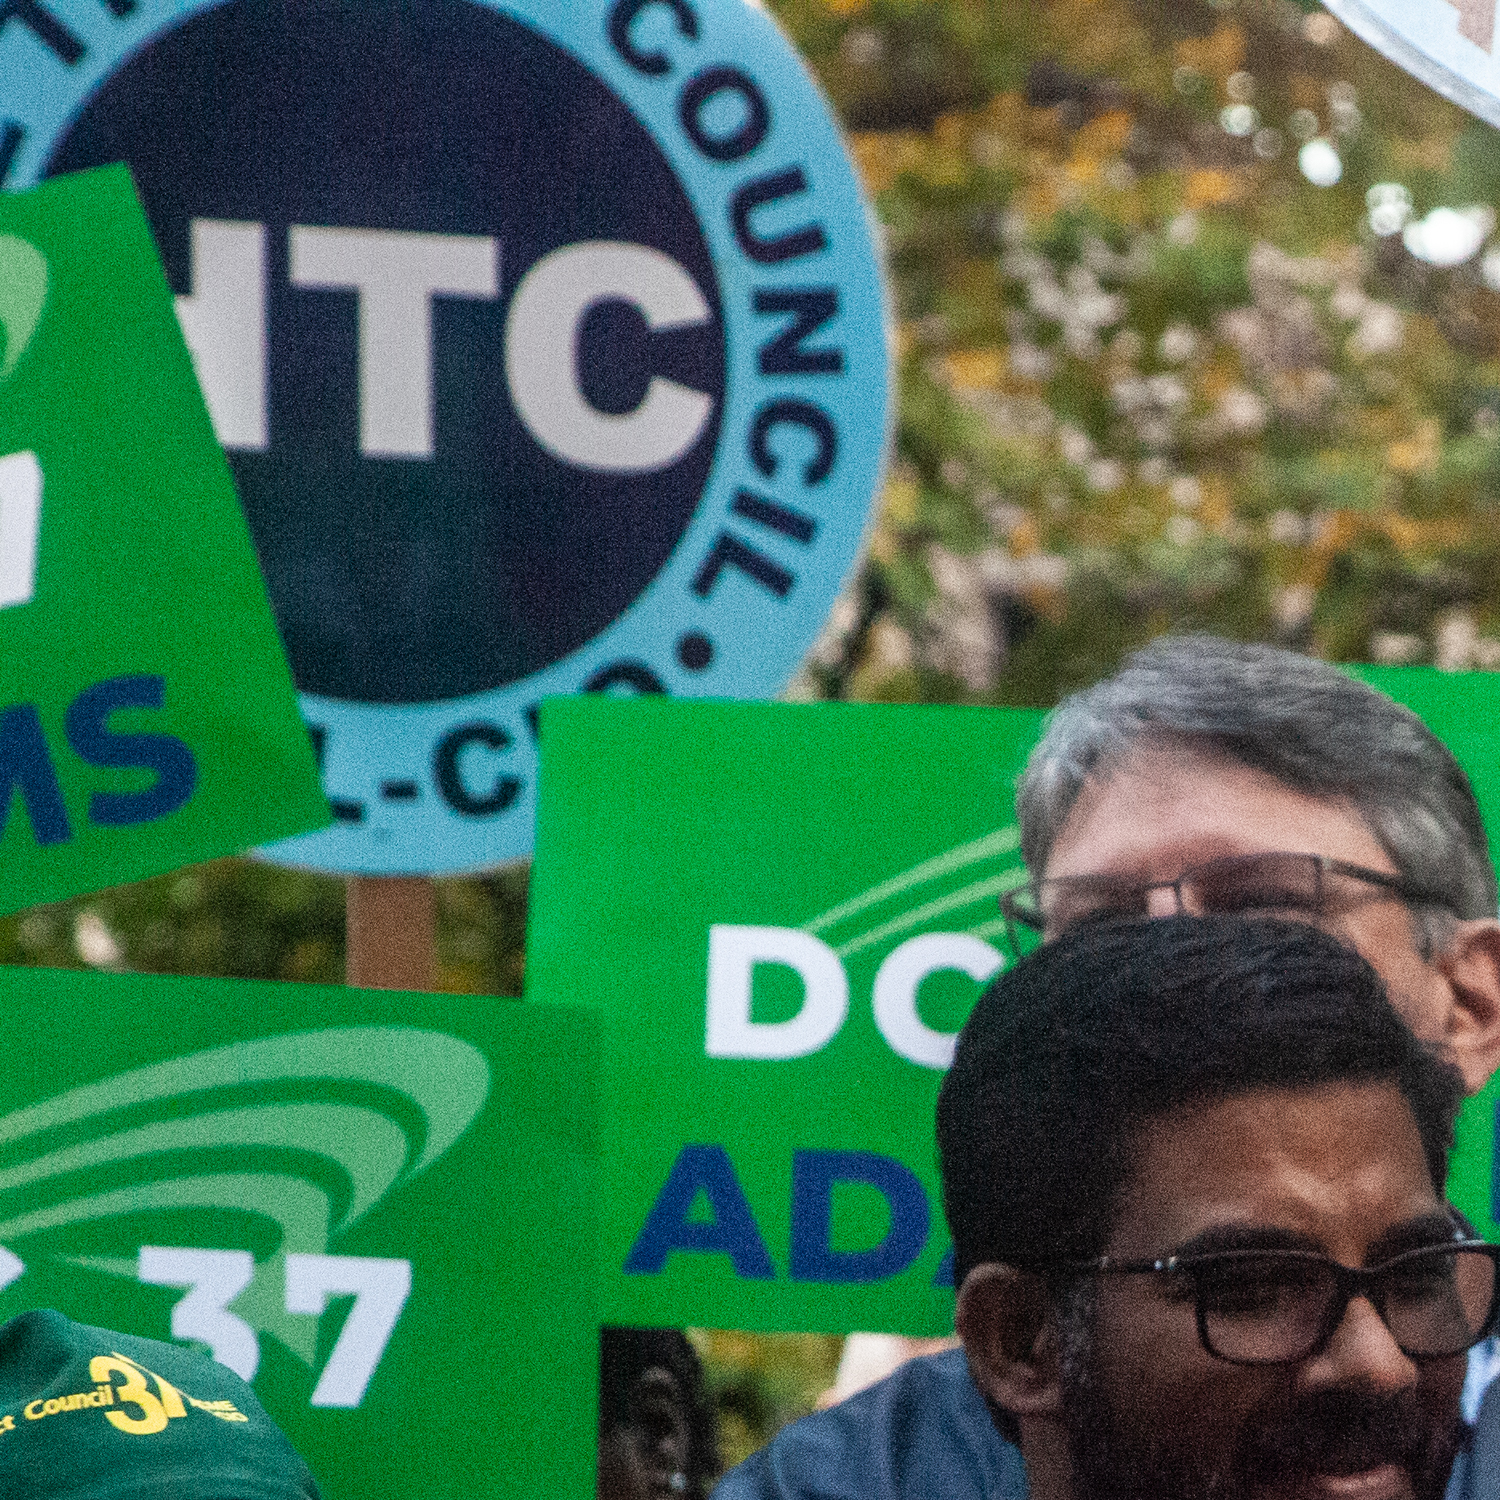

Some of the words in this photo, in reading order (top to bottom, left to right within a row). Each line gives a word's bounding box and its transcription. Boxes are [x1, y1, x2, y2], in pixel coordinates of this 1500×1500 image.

[607, 0, 844, 600] COUNCIL
[704, 922, 1006, 1071] DC
[621, 1142, 958, 1289] AD
[137, 1245, 413, 1409] 37
[23, 1384, 114, 1421] Council
